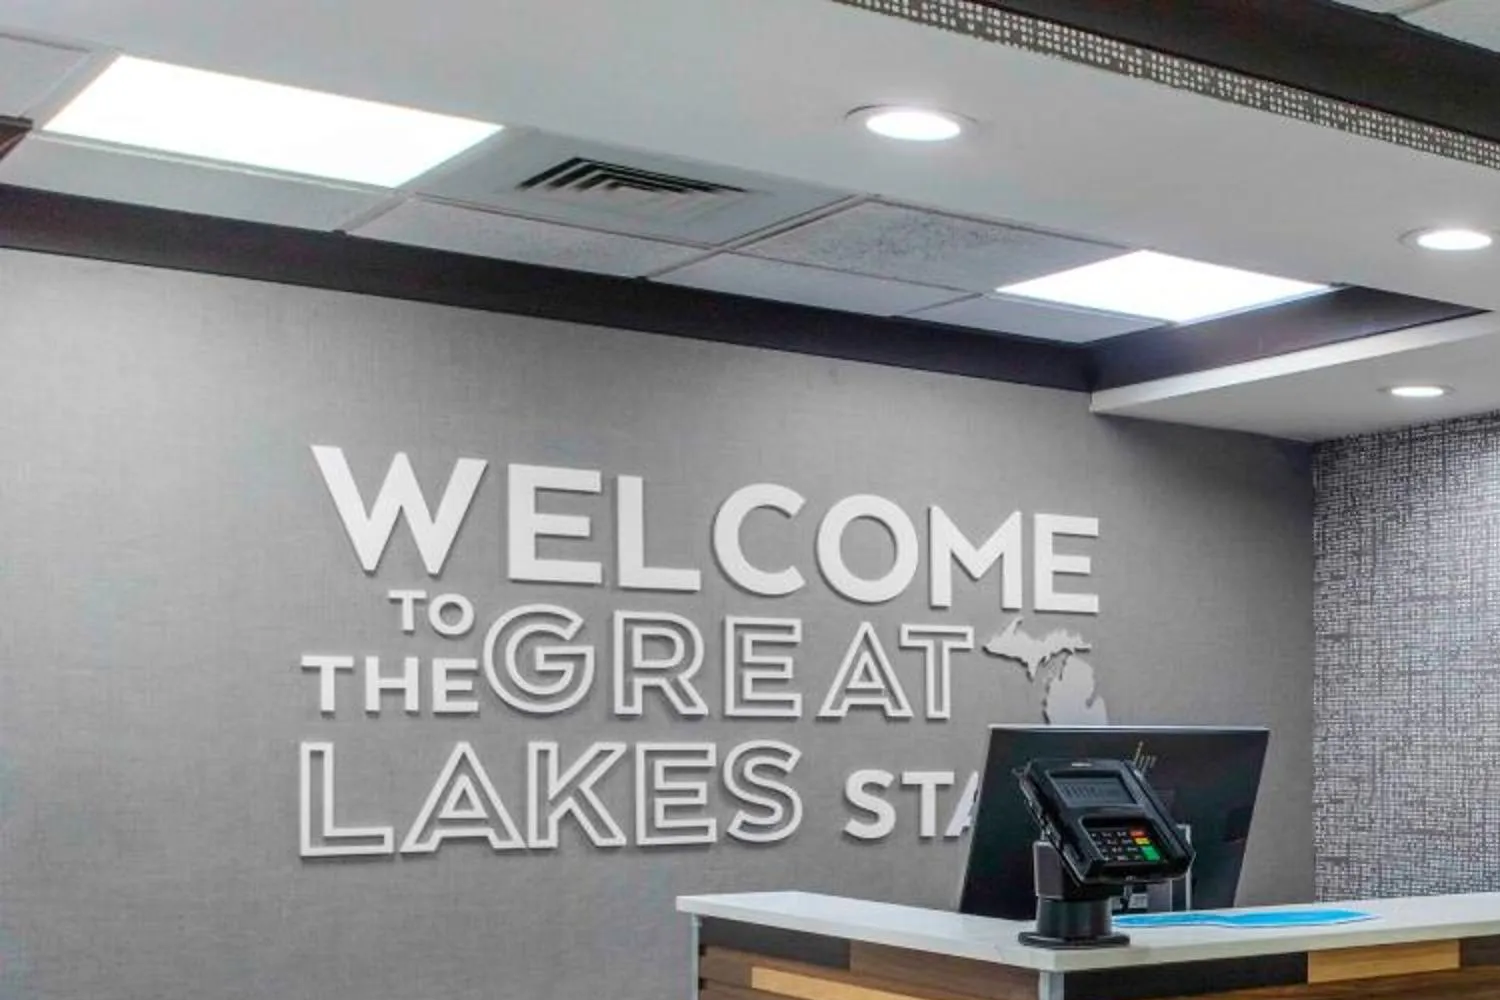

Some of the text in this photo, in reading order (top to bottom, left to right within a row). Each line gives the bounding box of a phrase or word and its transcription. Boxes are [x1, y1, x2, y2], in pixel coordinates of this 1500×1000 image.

[311, 445, 1099, 613] WELCOME
[301, 603, 975, 720] THE GREAT
[388, 589, 475, 635] TO
[299, 739, 803, 858] LAKES
